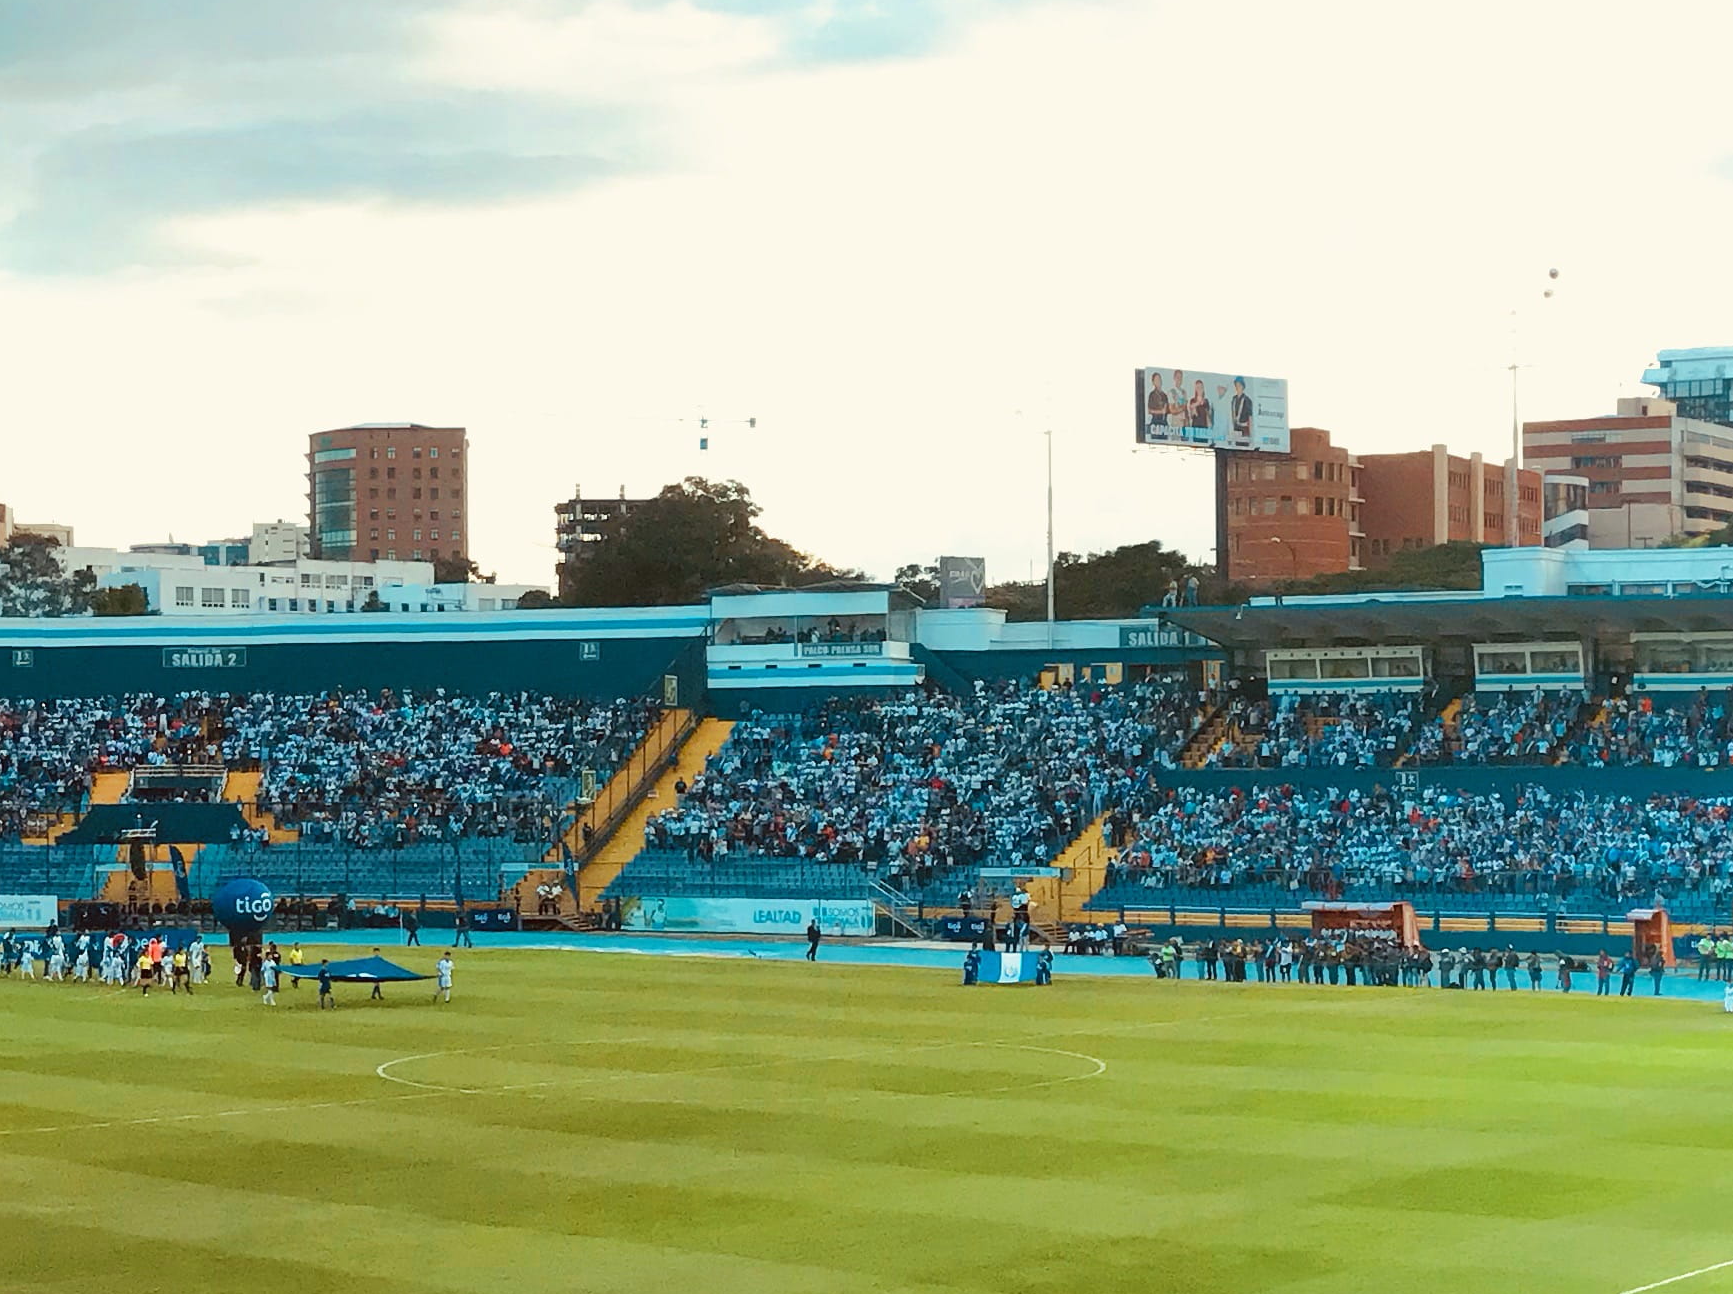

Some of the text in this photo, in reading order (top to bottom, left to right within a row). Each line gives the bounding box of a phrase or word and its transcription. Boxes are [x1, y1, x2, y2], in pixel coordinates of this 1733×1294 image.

[1129, 632, 1179, 646] SALIDA
[172, 653, 236, 666] SALIDA 2
[236, 892, 272, 921] tigo
[753, 910, 801, 924] LEALTAD
